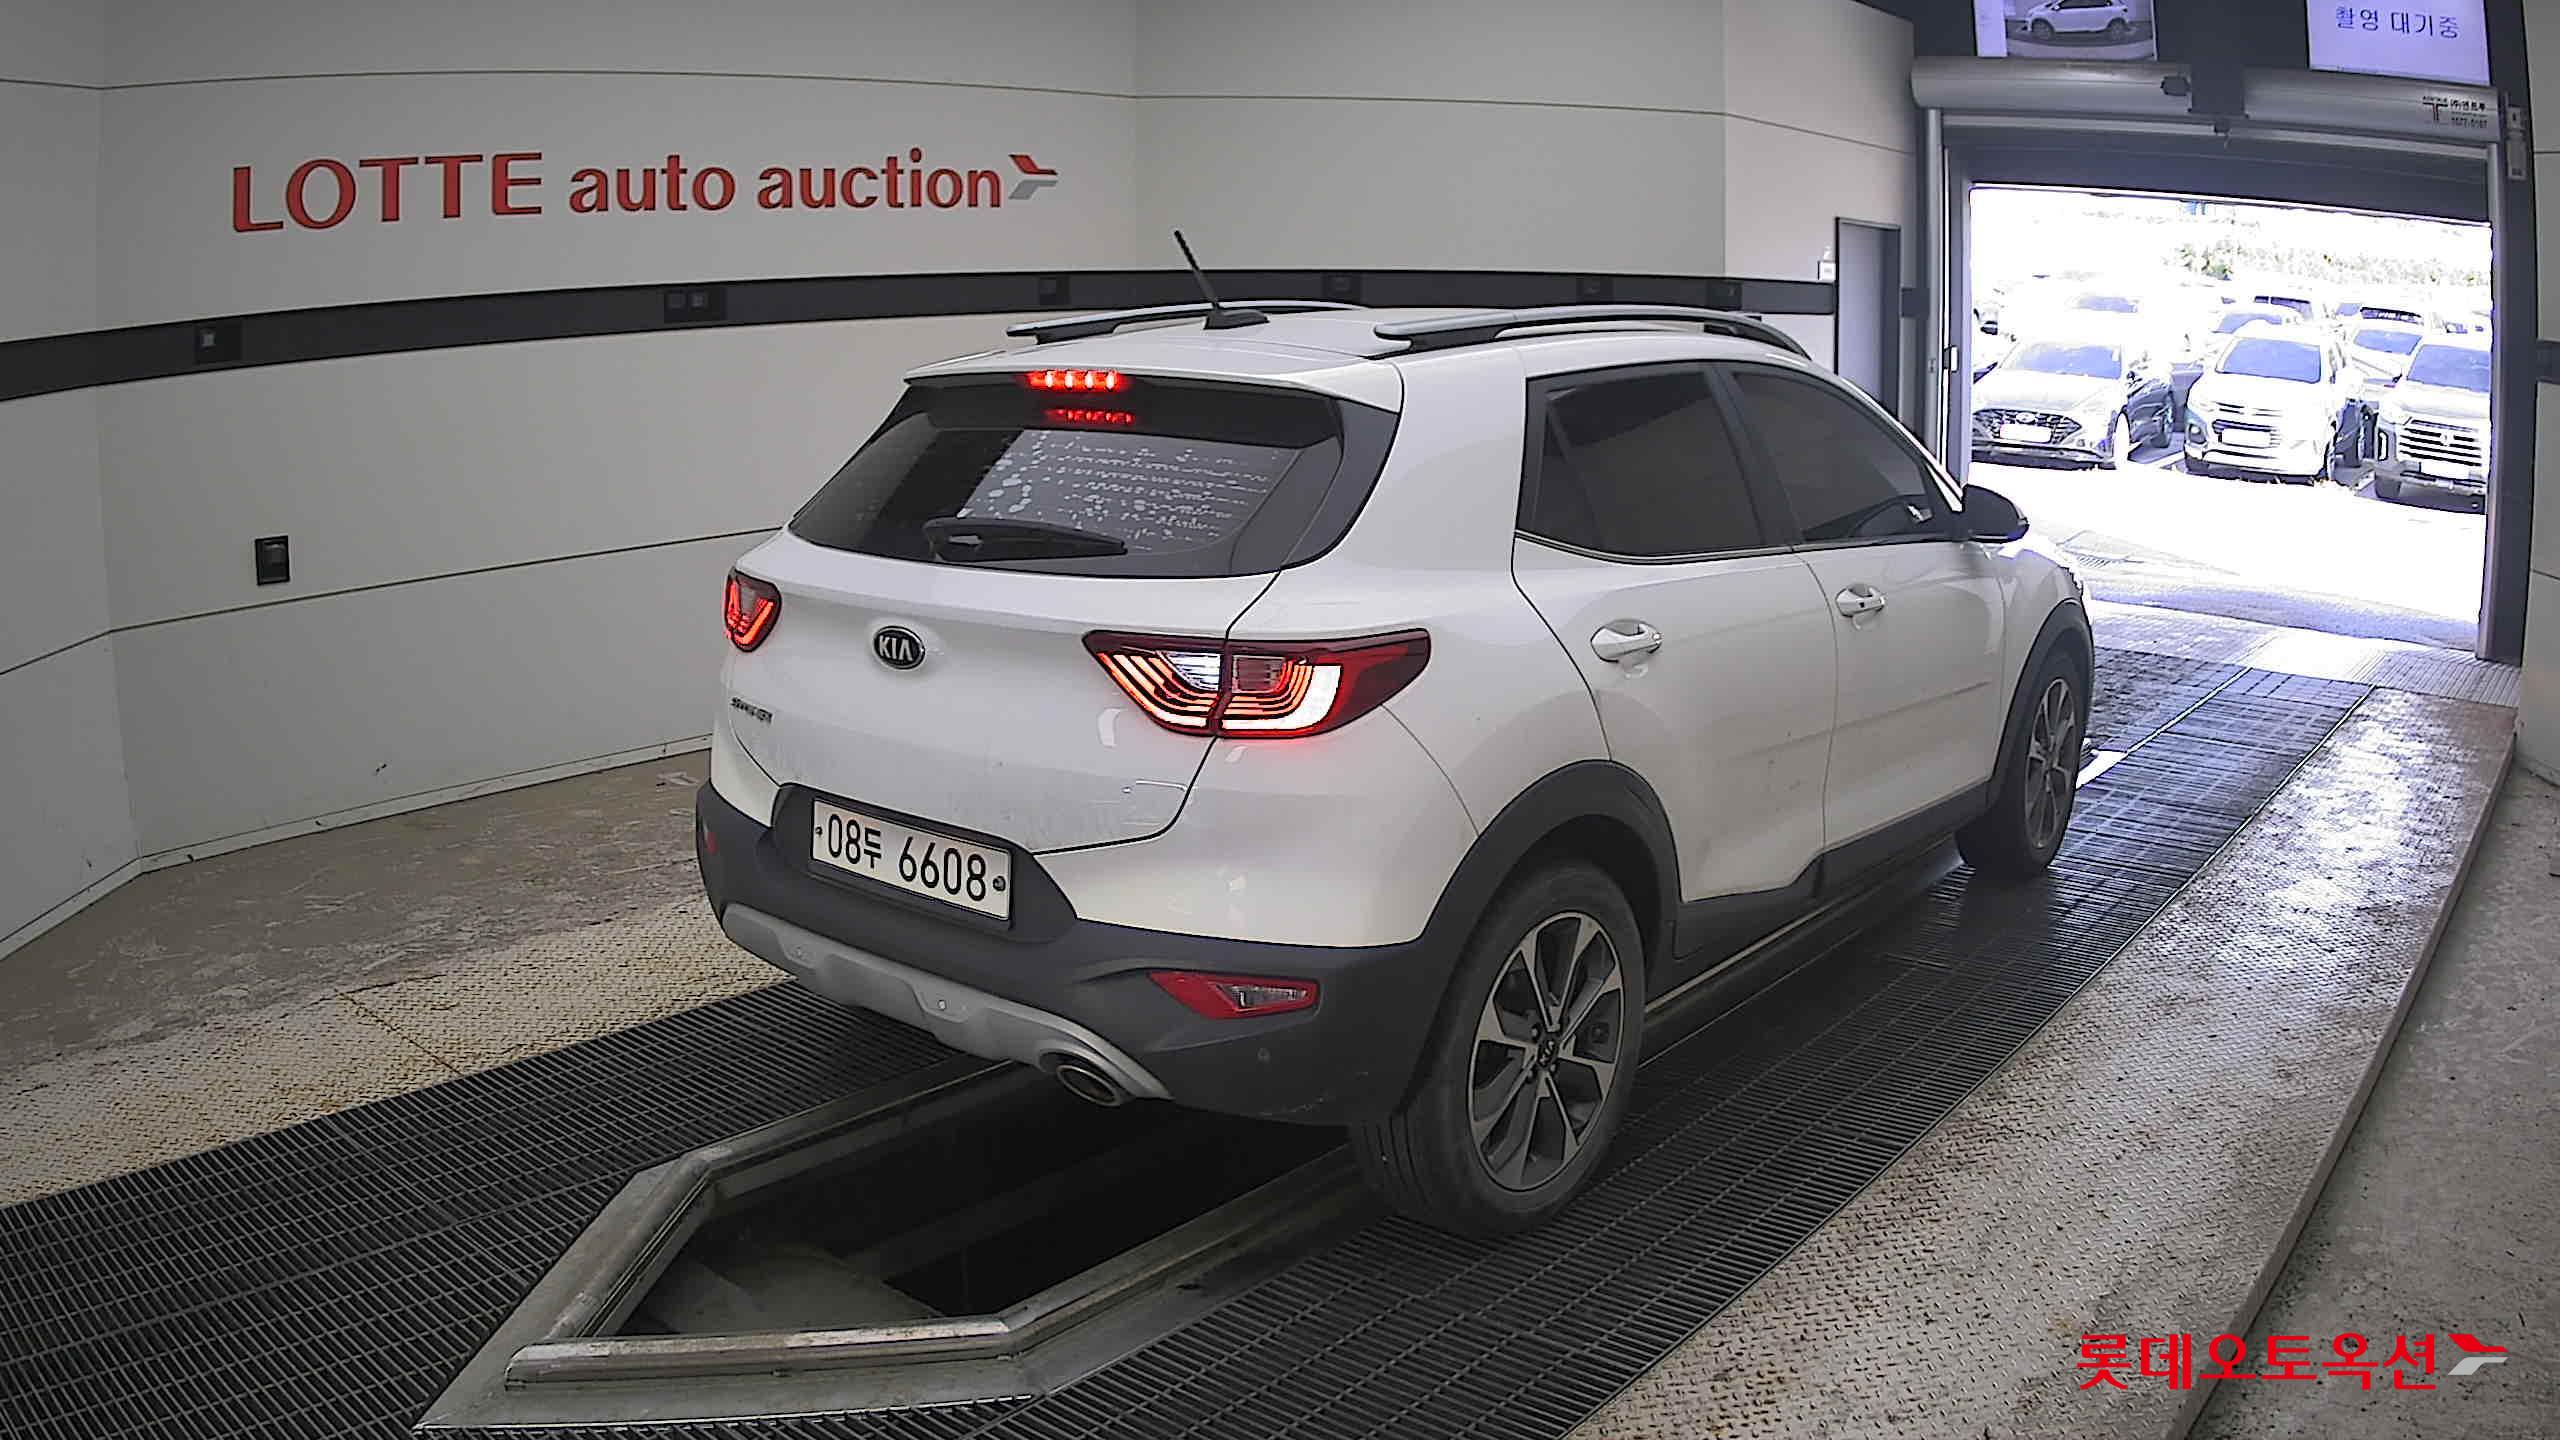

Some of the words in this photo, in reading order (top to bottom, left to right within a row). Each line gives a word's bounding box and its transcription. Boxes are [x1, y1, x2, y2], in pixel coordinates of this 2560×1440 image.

[2336, 7, 2379, 31] 촬영
[2391, 12, 2458, 39] 대기중
[232, 152, 542, 233] LOTTE
[568, 154, 736, 213] auto
[757, 147, 1002, 208] auction
[879, 635, 913, 661] KIA
[828, 814, 882, 869] 08두
[899, 836, 986, 902] 6608
